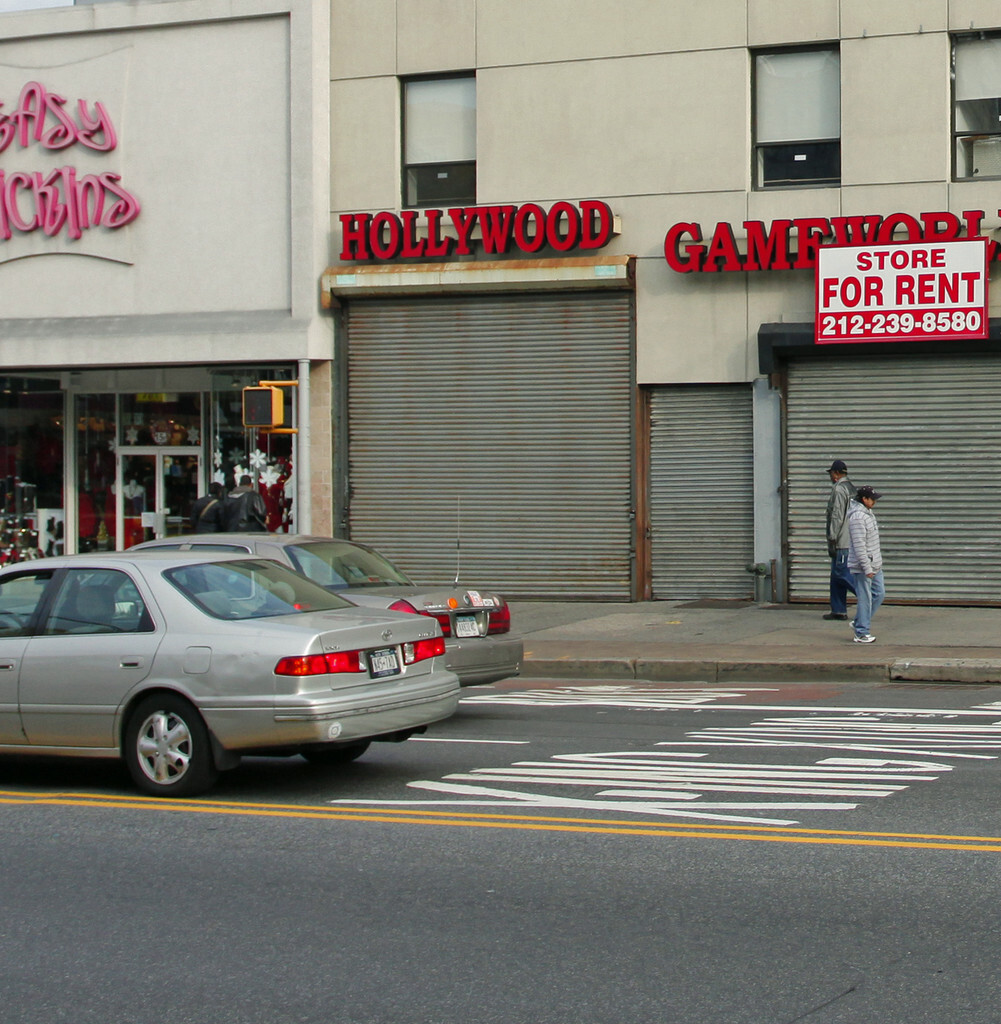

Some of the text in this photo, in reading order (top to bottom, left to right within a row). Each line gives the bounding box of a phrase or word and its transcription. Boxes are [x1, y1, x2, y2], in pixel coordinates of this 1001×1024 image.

[340, 200, 613, 261] HOLLYWOOD
[856, 248, 946, 272] STORE
[822, 271, 981, 308] FOR RENT
[822, 310, 981, 336] 212-239-8580
